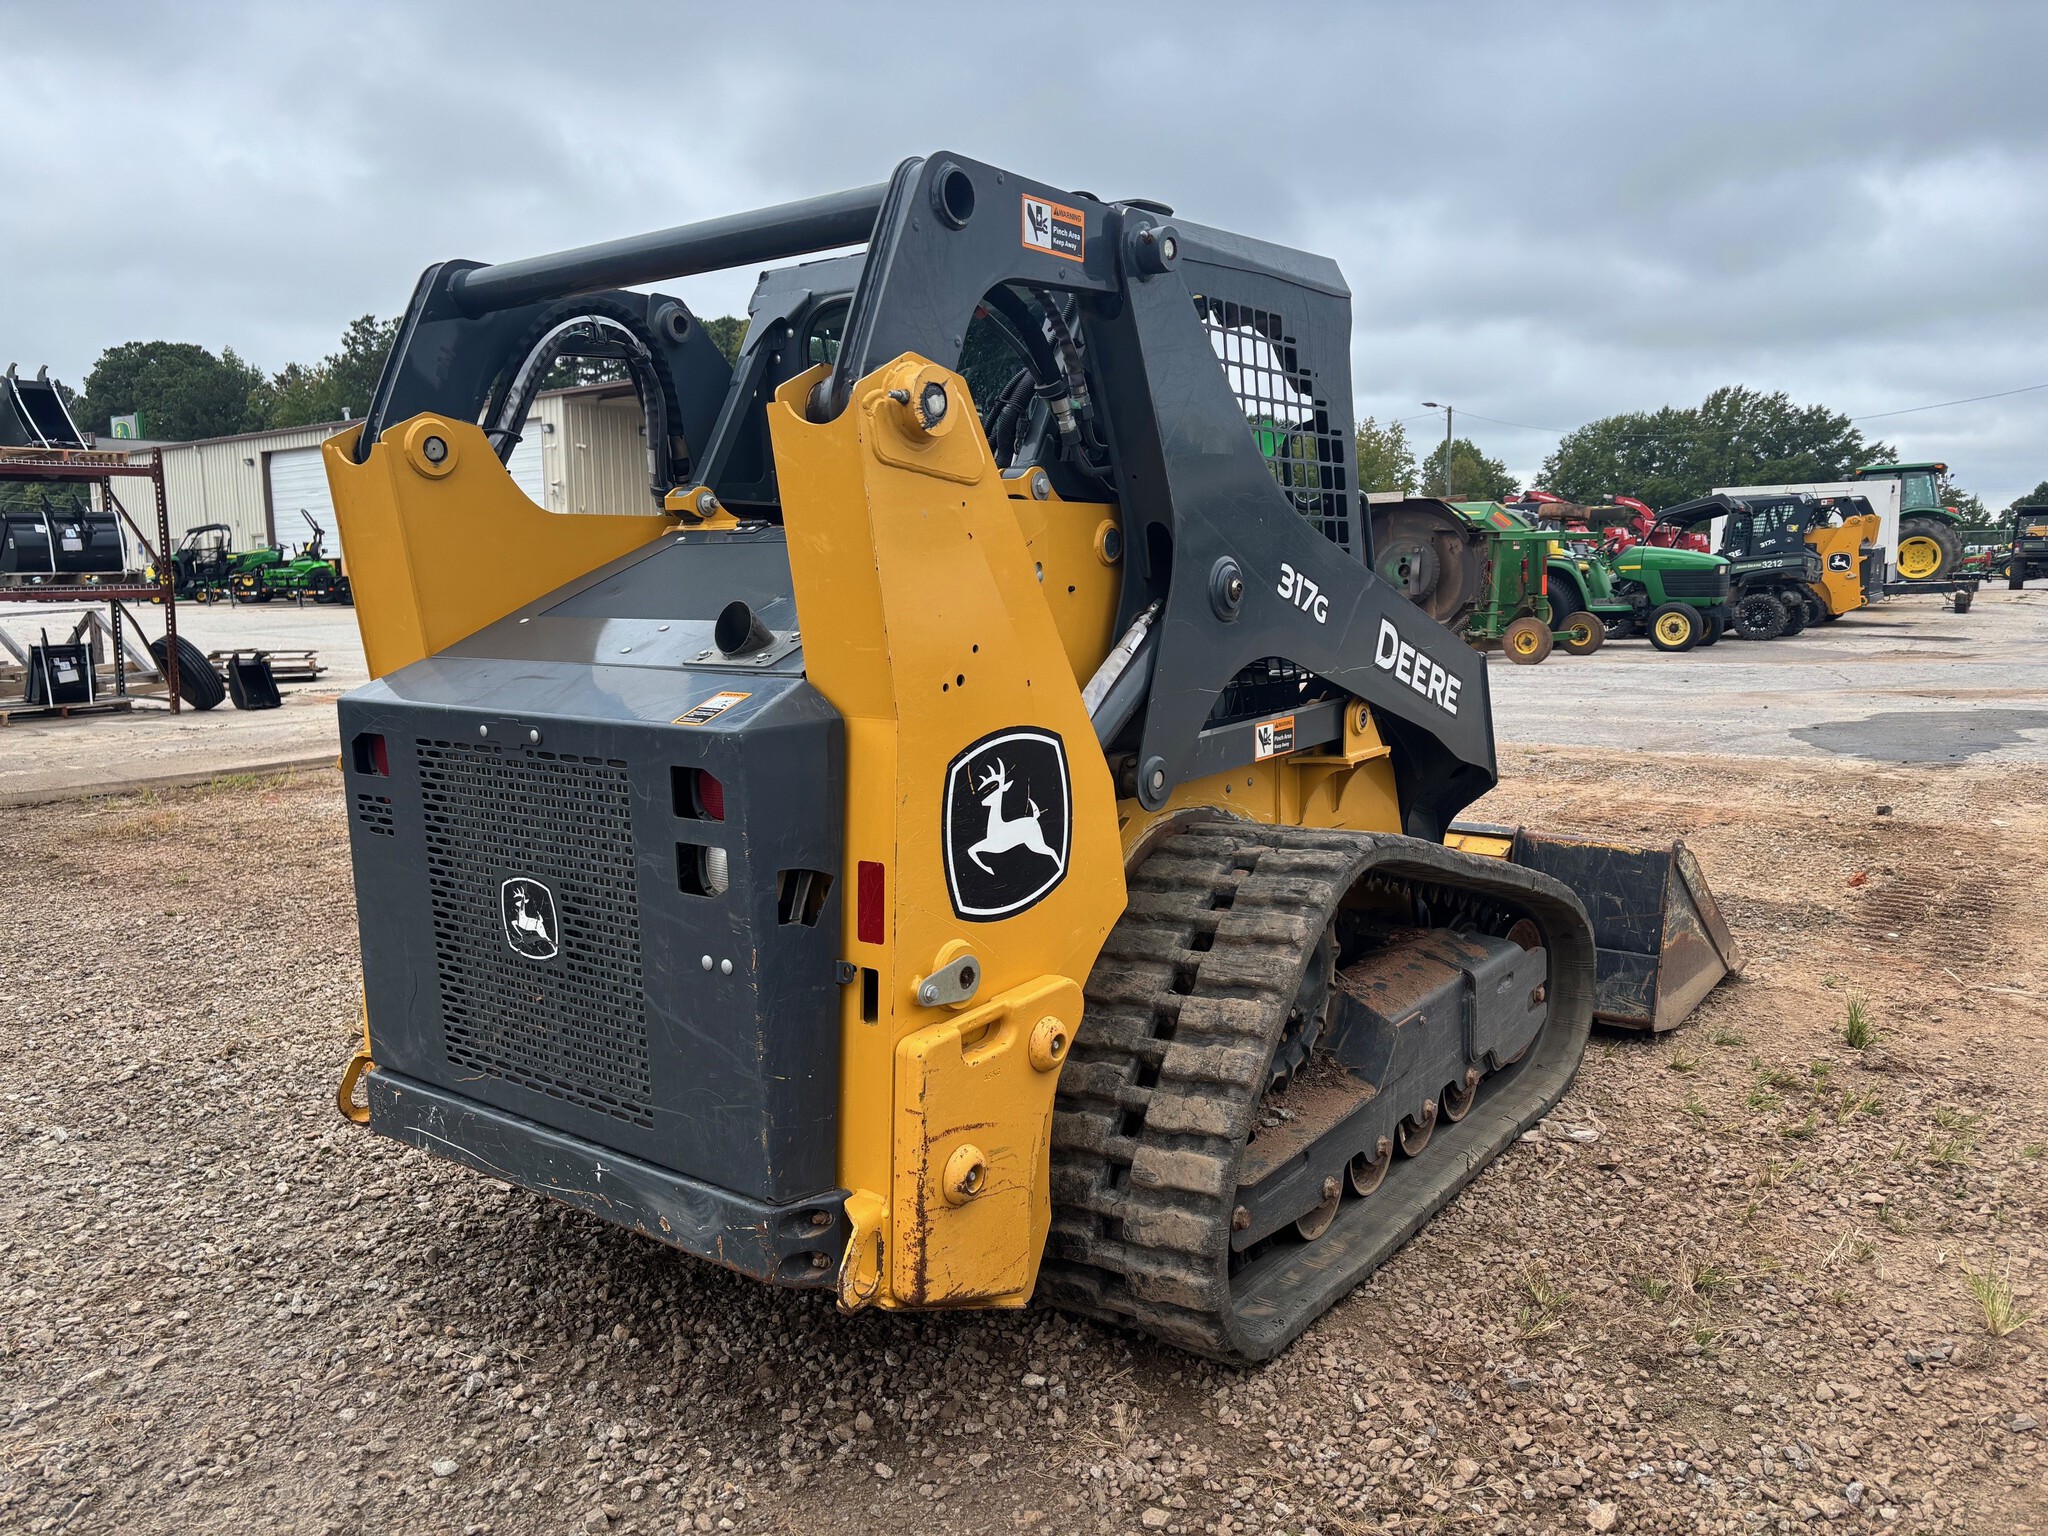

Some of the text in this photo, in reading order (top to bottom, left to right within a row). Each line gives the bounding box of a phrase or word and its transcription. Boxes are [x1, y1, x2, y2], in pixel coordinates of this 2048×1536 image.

[1058, 209, 1082, 223] WARNING
[1053, 226, 1081, 240] Pinch Area
[1053, 237, 1077, 251] Keep Away
[1761, 560, 1783, 568] 3212
[1277, 562, 1329, 624] 317G
[1375, 618, 1462, 715] DEERE
